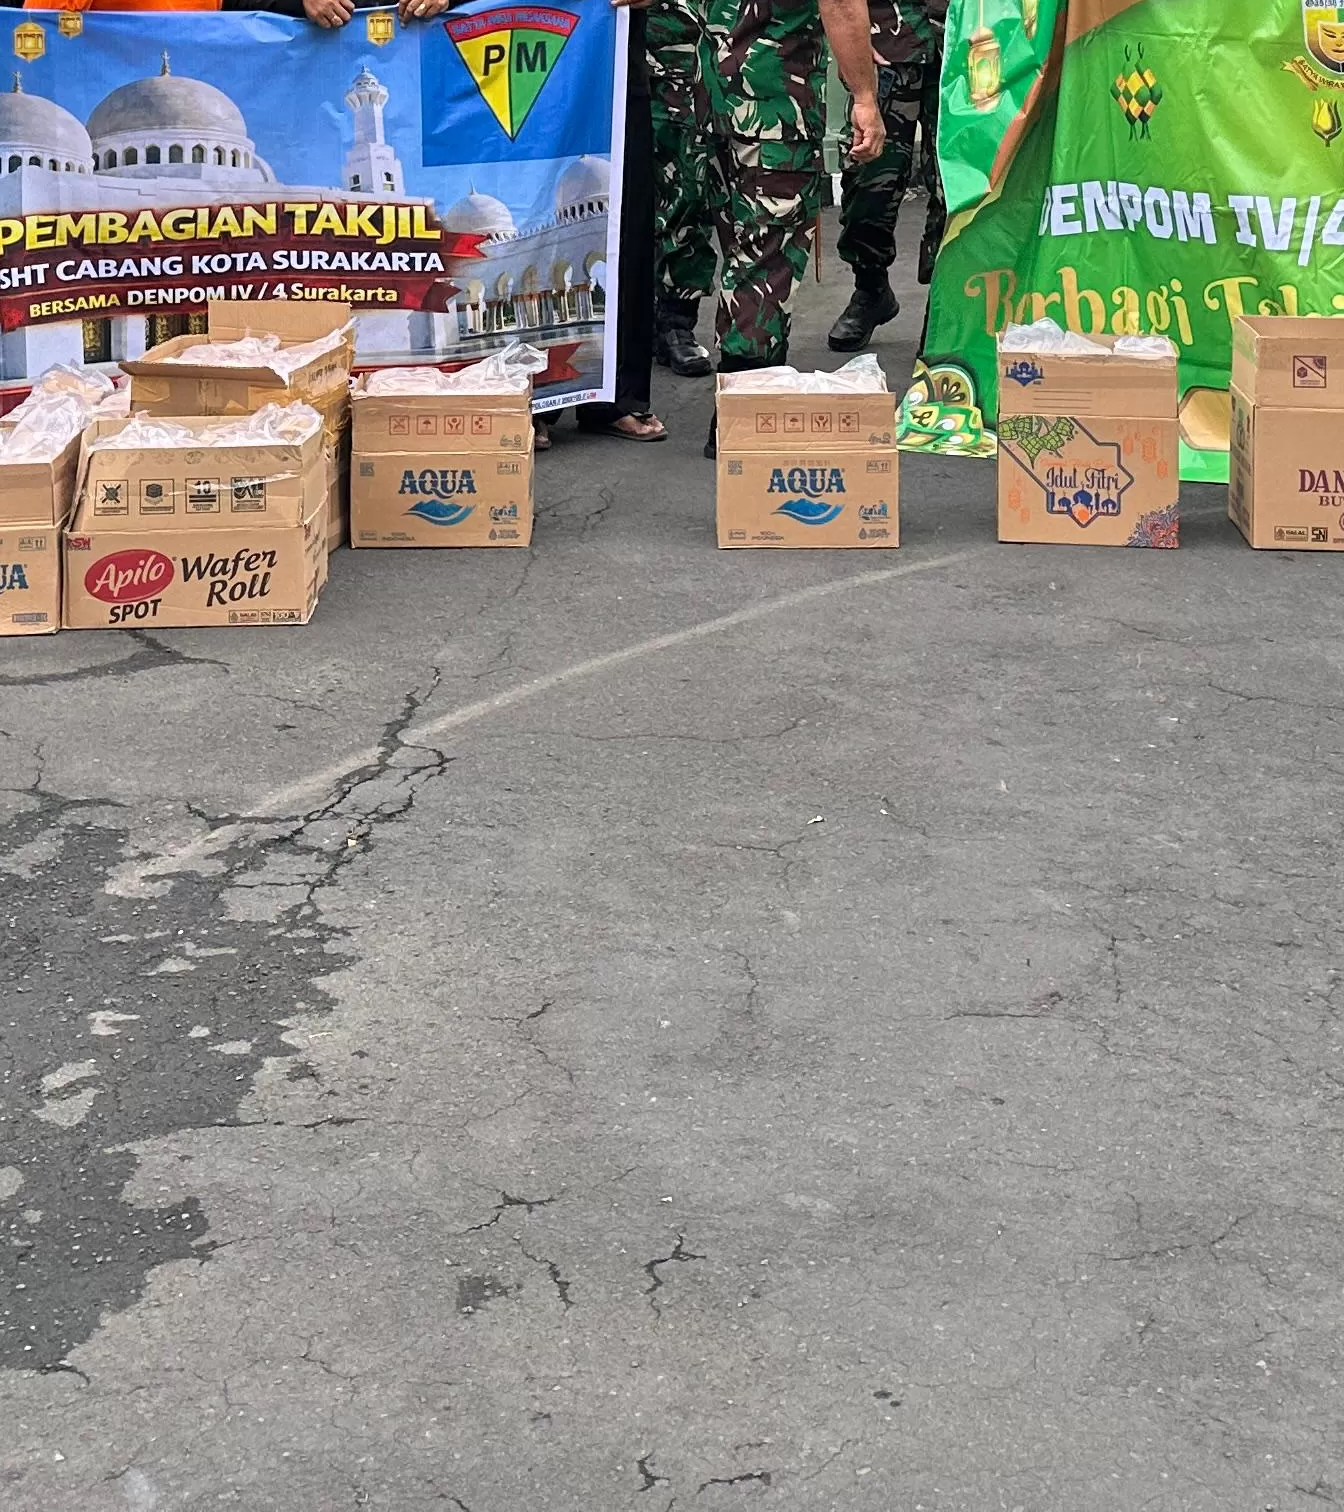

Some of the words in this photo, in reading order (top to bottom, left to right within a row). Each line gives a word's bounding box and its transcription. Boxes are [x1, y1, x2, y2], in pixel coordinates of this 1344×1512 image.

[283, 203, 443, 245] TAKJIL
[56, 257, 182, 281] CABANG
[193, 253, 263, 275] KOTA
[272, 250, 444, 272] SURAKARTA
[29, 293, 121, 318] BERSAMA
[127, 284, 230, 306] DENPOM
[231, 284, 254, 300] IV
[291, 281, 398, 303] Surakarta
[398, 469, 477, 499] AQUA
[767, 467, 846, 498] AQUA
[1046, 466, 1078, 489] Idul
[92, 553, 166, 598] Apilo
[181, 548, 278, 582] Wafer
[206, 572, 271, 607] Roll
[109, 598, 162, 624] SPOT
